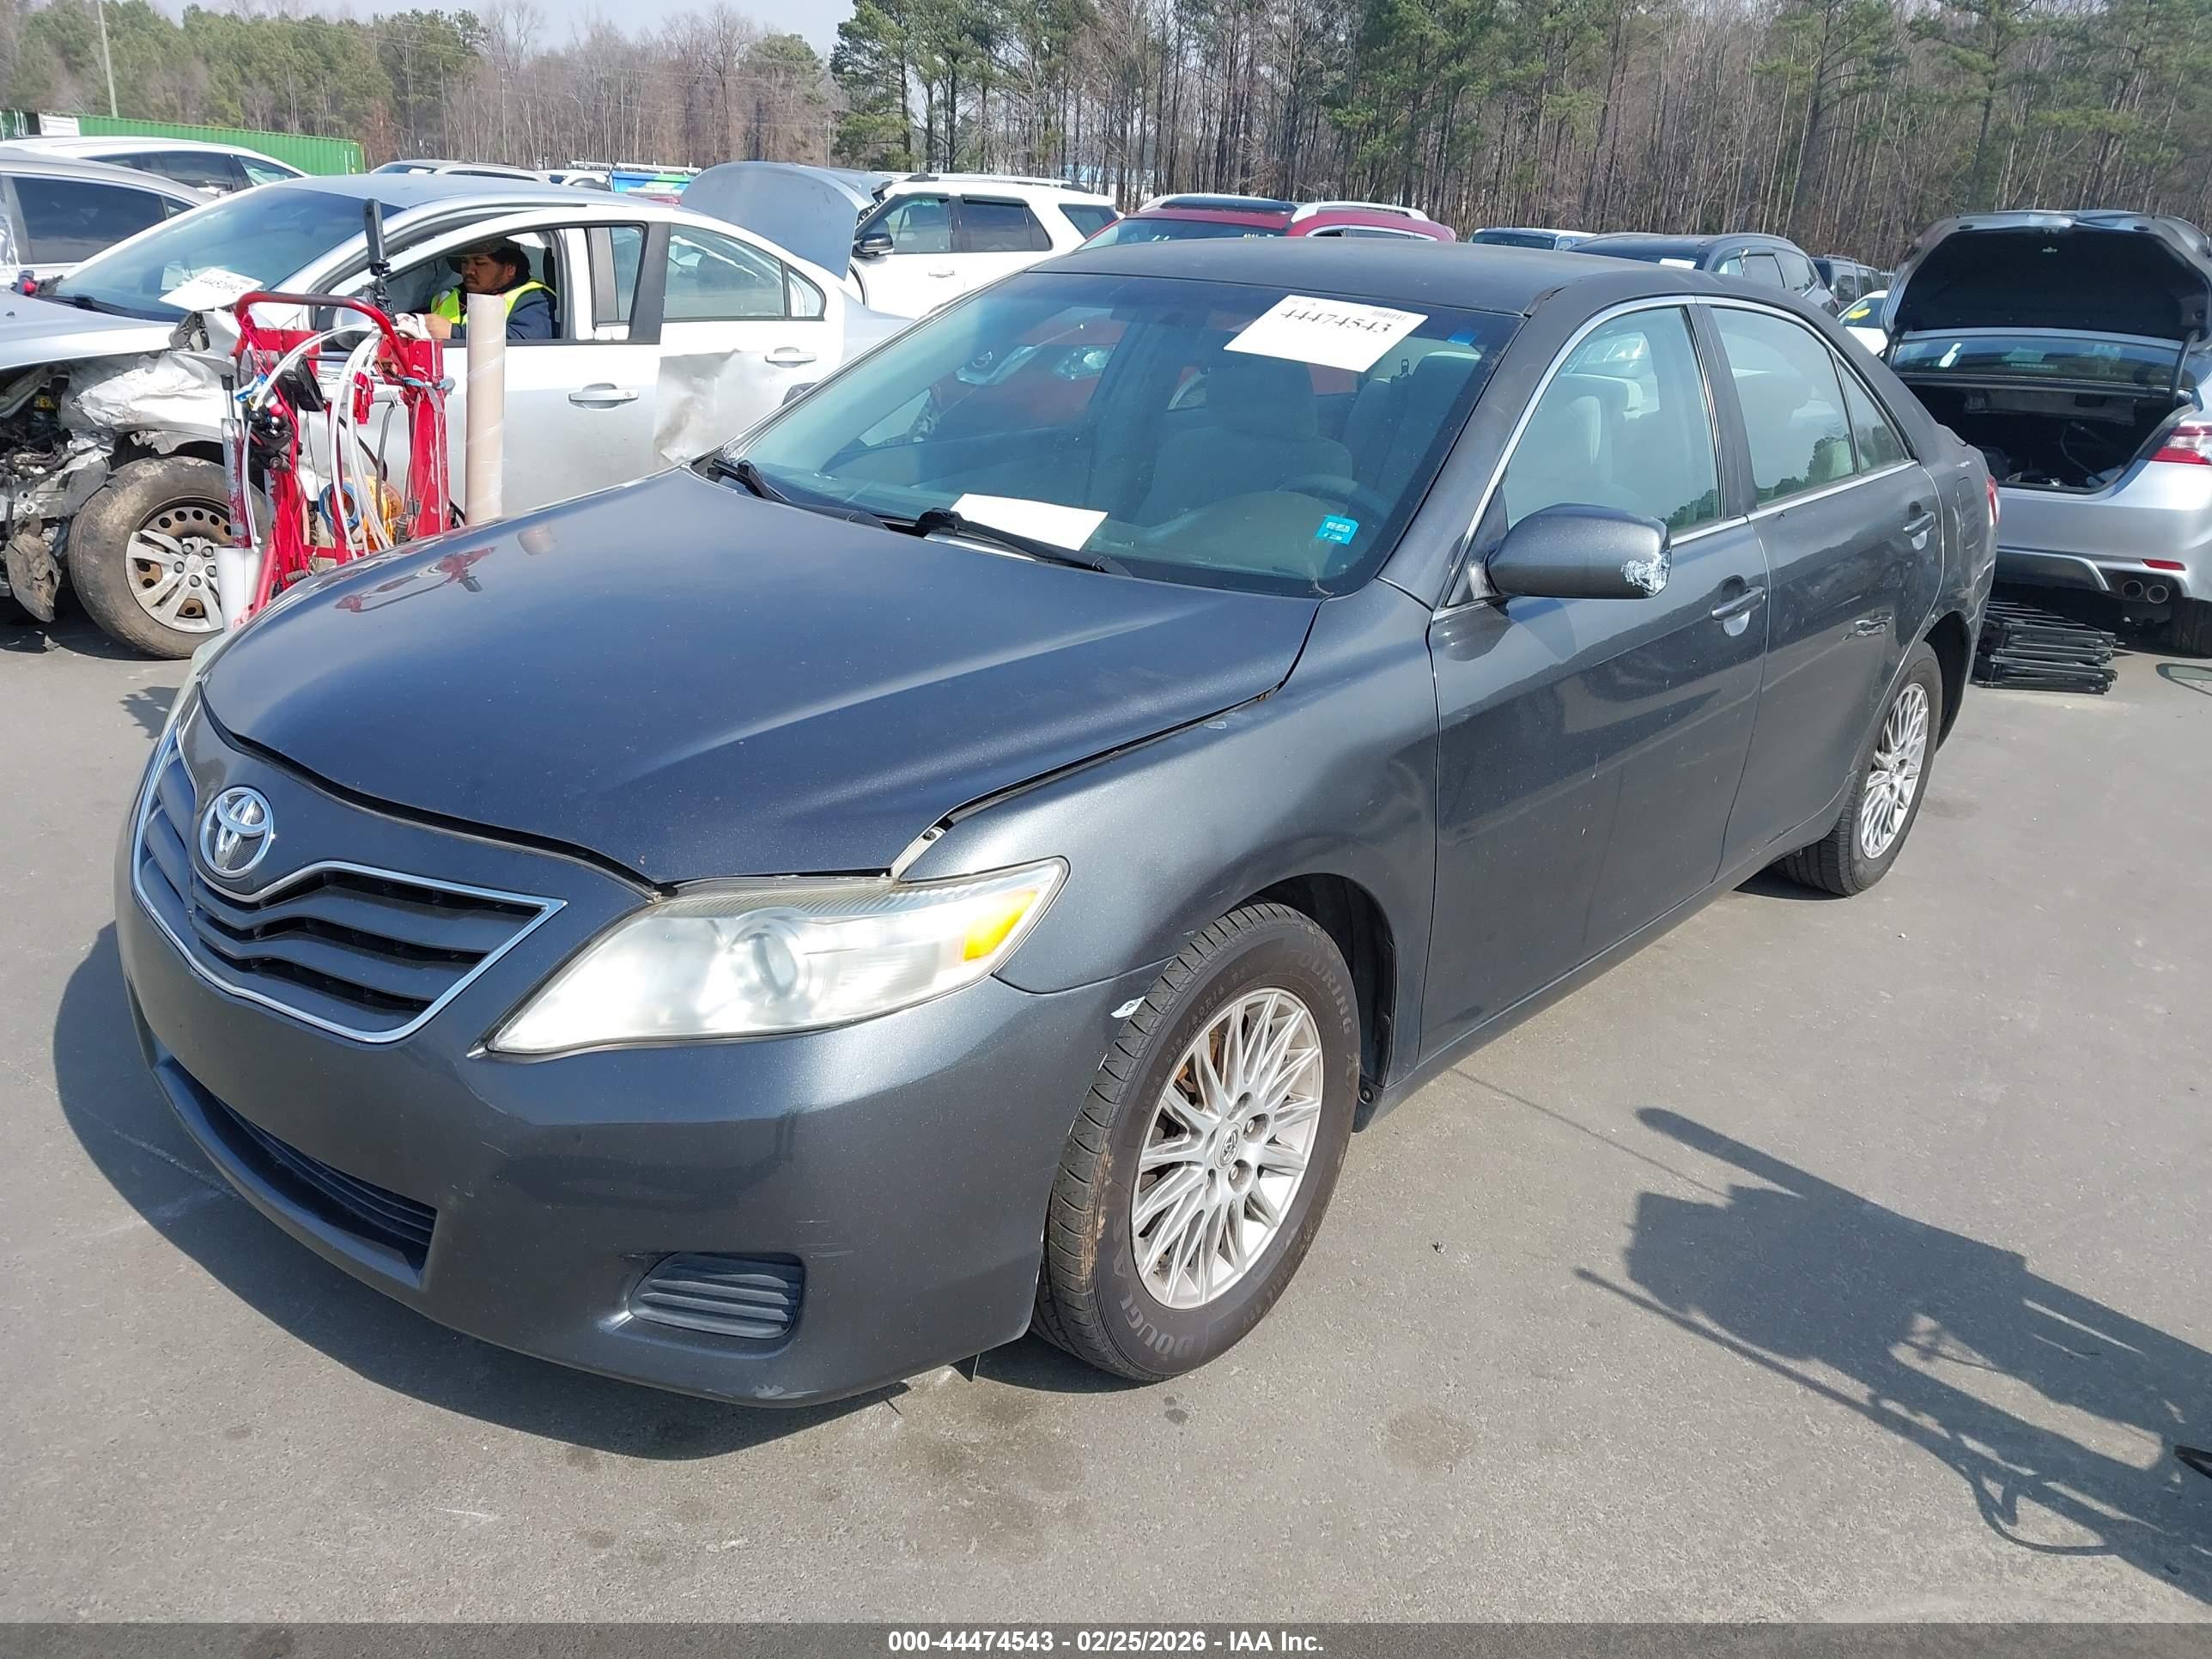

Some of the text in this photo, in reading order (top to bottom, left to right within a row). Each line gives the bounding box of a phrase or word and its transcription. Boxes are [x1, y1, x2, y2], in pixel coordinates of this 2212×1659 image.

[1279, 309, 1392, 333] 44474543
[1291, 950, 1355, 1035] OURING
[1112, 1214, 1196, 1350] DOUGLAS
